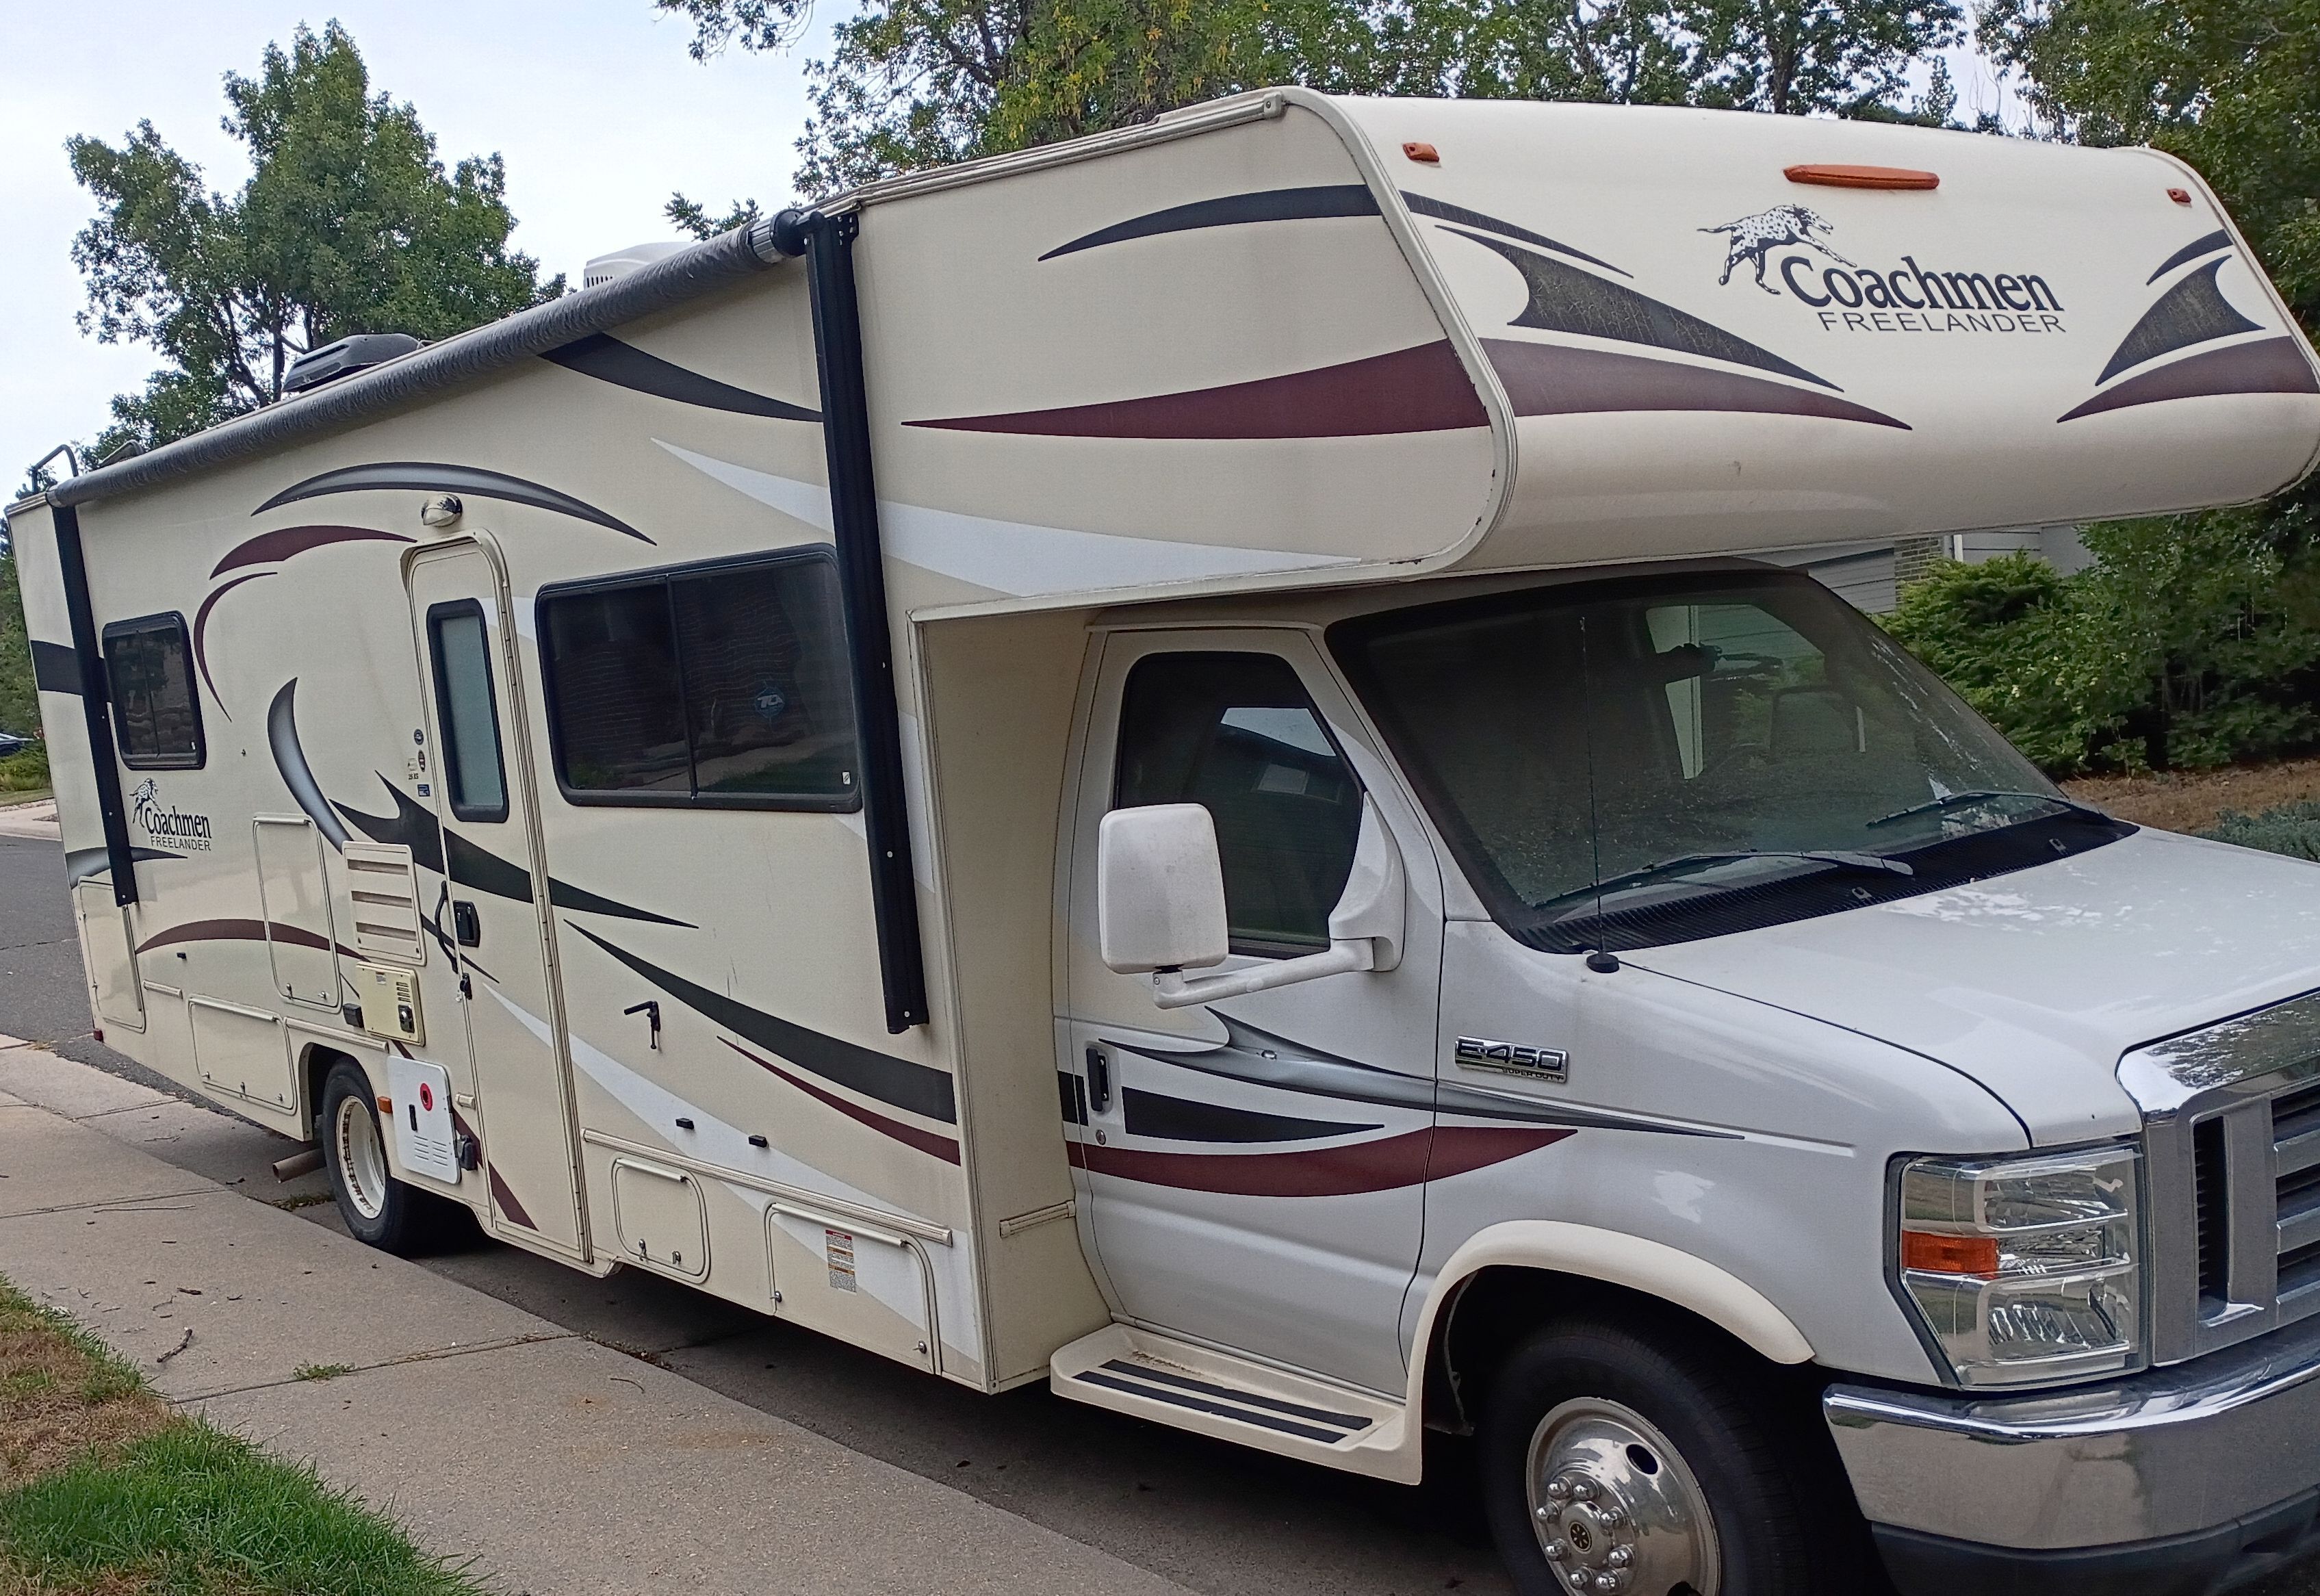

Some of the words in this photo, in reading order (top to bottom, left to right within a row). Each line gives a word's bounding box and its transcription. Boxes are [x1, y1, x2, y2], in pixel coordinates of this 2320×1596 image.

[1779, 256, 2065, 311] Coachmen
[1818, 312, 2065, 333] FREELANDER
[145, 806, 211, 838] Coachmen
[151, 836, 211, 851] FREELANDER
[1457, 1039, 1562, 1071] E-450
